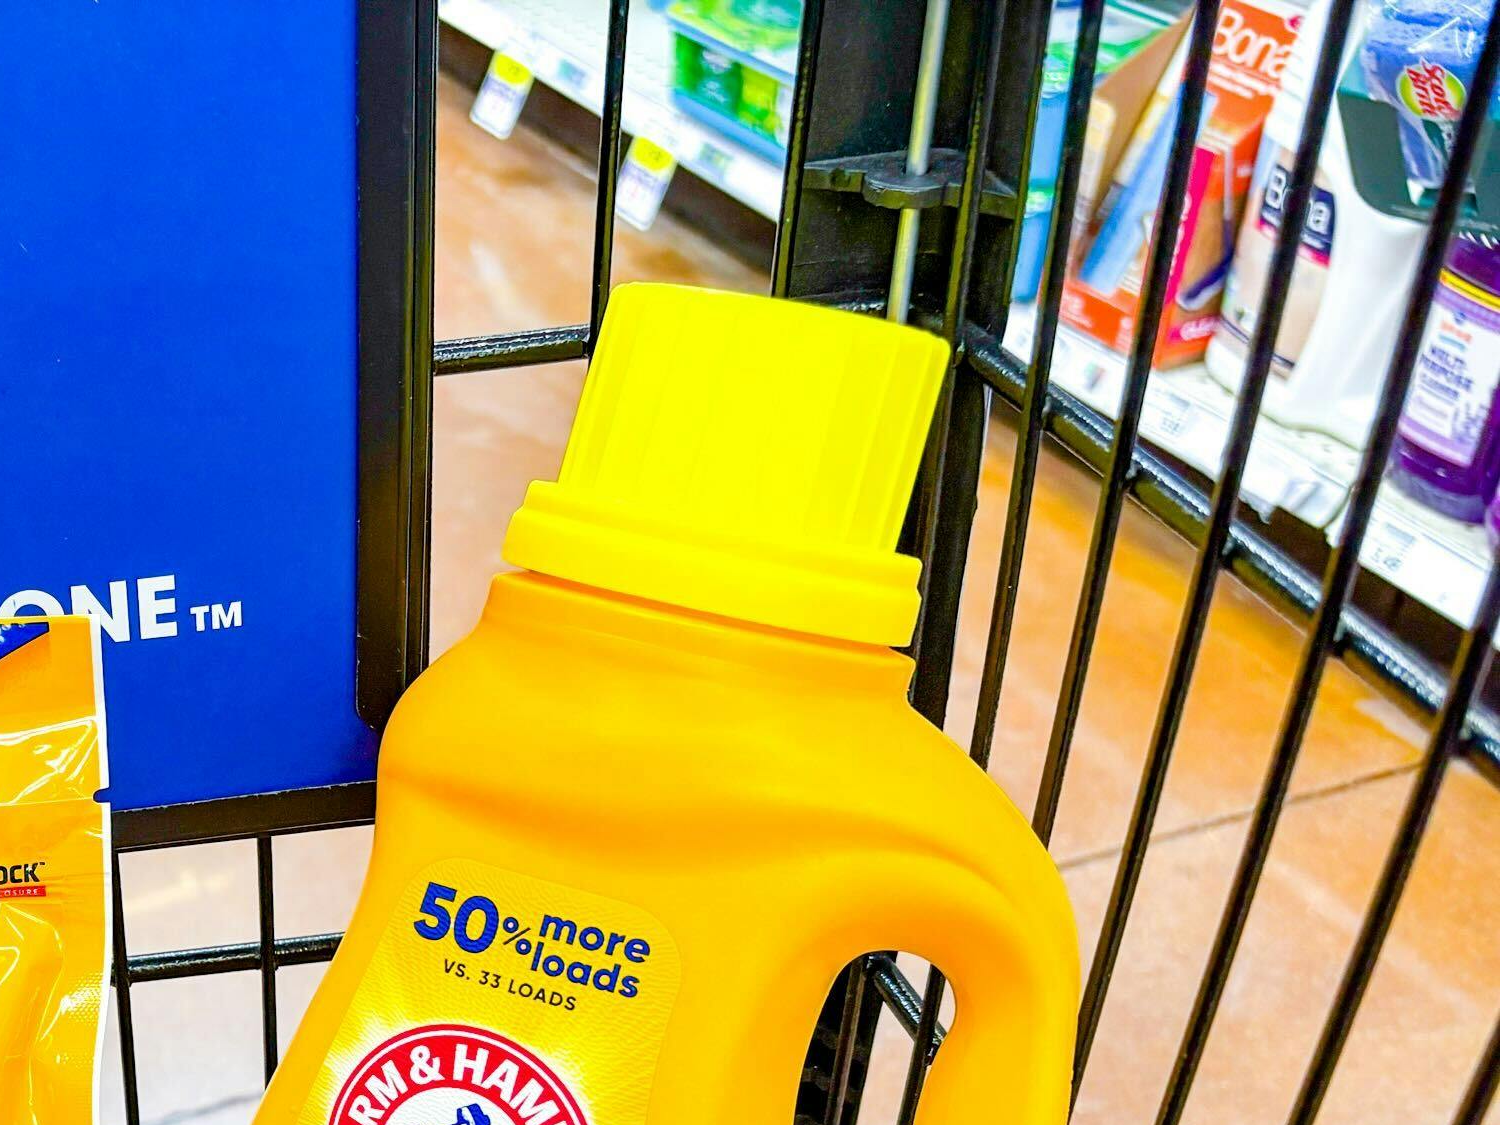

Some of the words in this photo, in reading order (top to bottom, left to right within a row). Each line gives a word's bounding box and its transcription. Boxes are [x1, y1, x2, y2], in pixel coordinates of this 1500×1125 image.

[1211, 7, 1294, 79] Bona
[1265, 168, 1332, 236] Ba
[412, 881, 532, 956] 50%
[539, 912, 651, 964] more
[442, 959, 471, 982] VS.
[479, 970, 501, 990] 33
[507, 978, 578, 1012] LOADS
[529, 945, 641, 999] loads
[408, 1044, 447, 1086] &
